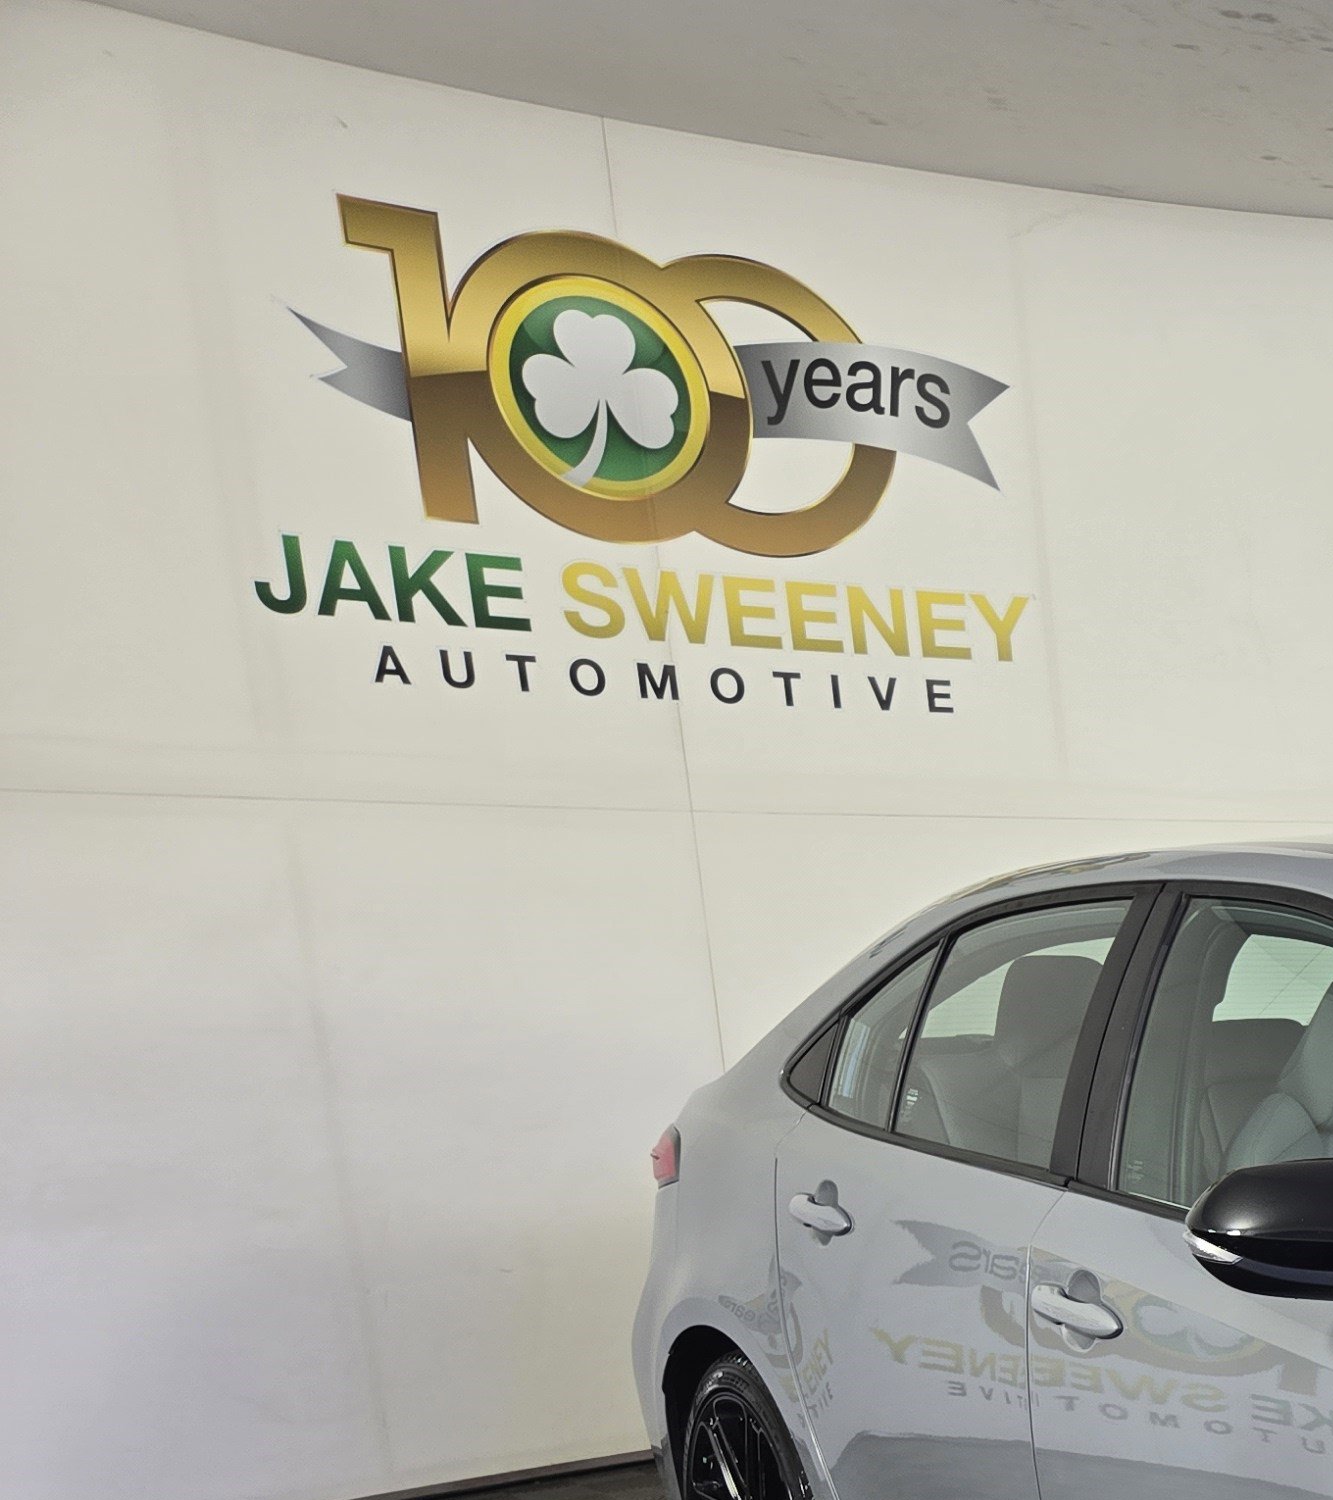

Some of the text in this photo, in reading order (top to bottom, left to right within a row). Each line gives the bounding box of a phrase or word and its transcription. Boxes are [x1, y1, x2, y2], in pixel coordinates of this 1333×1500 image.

[763, 355, 951, 429] years
[255, 533, 1030, 662] JAKE SWEENEY
[374, 644, 955, 713] AUTOMOTIVE
